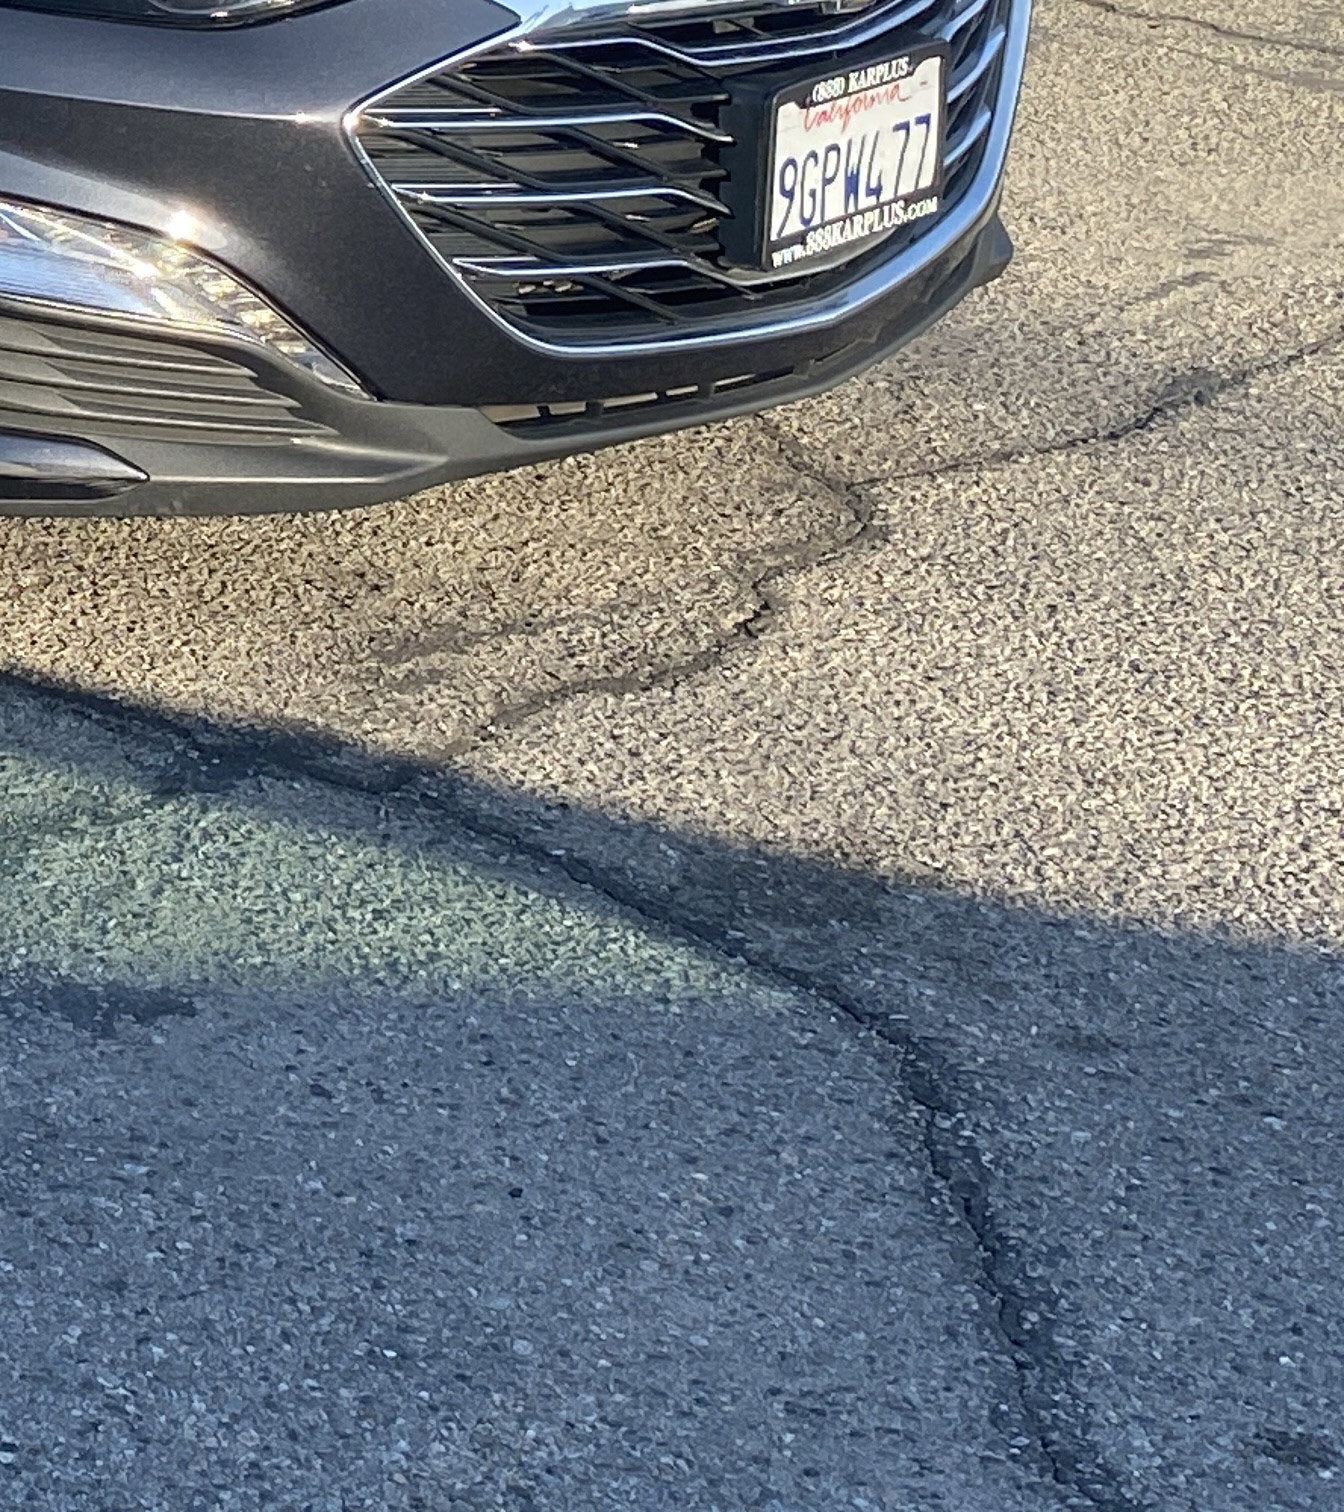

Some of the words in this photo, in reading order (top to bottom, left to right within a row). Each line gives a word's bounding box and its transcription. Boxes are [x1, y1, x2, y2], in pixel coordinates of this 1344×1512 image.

[848, 56, 911, 93] KARPLUS
[803, 82, 912, 134] California
[777, 112, 932, 238] 9GPW477
